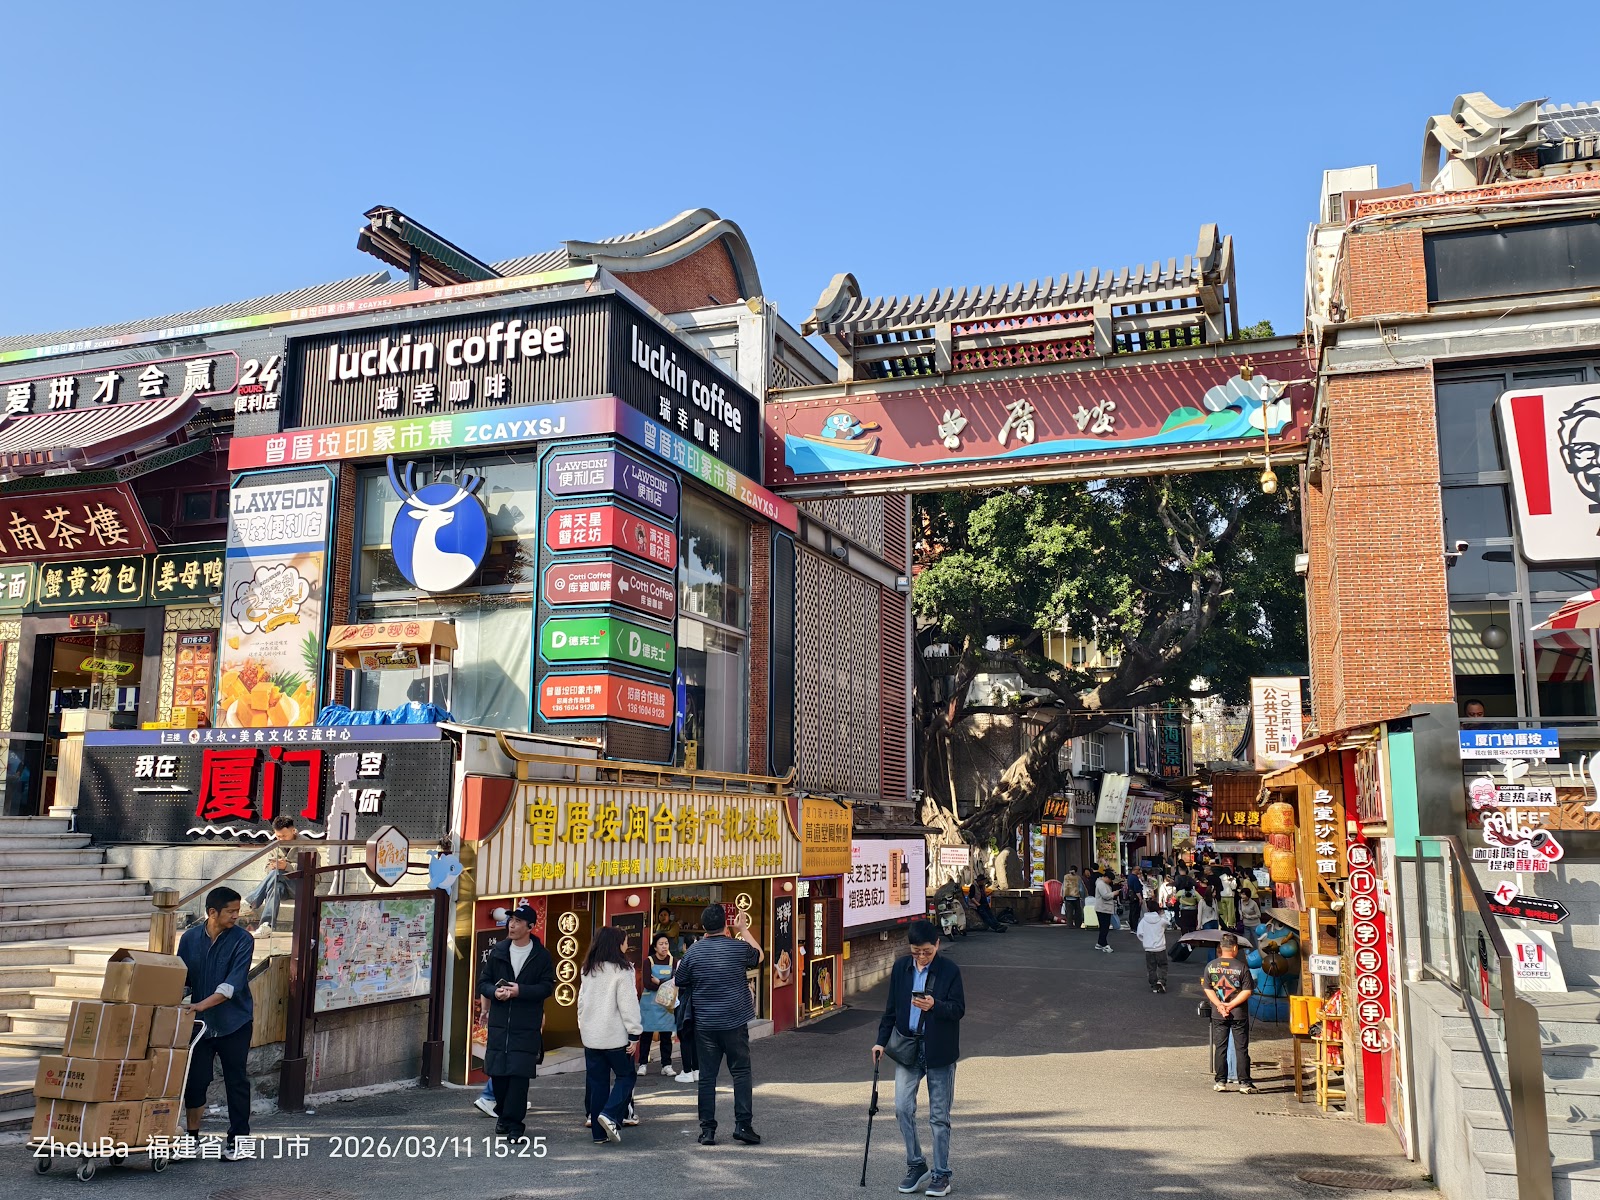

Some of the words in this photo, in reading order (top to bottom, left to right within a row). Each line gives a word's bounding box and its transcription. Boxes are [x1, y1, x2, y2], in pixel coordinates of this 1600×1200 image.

[328, 334, 435, 381] luckin
[445, 319, 565, 367] coffee
[239, 355, 281, 392] 24
[631, 324, 688, 398] luckin
[691, 377, 742, 434] coffee
[5, 358, 214, 414] 爱拼才会赢
[239, 384, 263, 394] HOURS
[376, 373, 507, 411] 瑞幸咖啡
[234, 392, 278, 413] 便利店
[658, 395, 720, 452] 瑞幸咖啡
[937, 398, 1117, 451] 曾厝垵
[265, 419, 453, 464] 曾厝垵印象市集
[464, 416, 567, 442] ZCAYXSJ
[556, 458, 605, 472] LAWSON
[644, 420, 737, 495] 曾厝垵印象市集
[740, 485, 779, 520] ZCAYXSJ
[558, 470, 605, 487] 便利店
[631, 465, 666, 493] LAWSON
[233, 486, 325, 514] LAWSON
[637, 482, 662, 508] 便利店
[0, 503, 130, 554] 南茶樓
[231, 511, 323, 544] 罗森便利店
[559, 512, 602, 529] 满天星
[558, 527, 602, 545] 簪花坊
[649, 527, 671, 549] 满天星
[44, 563, 139, 599] 蟹黄汤包
[156, 556, 224, 592] 姜母鸭
[568, 573, 587, 581] Cotti
[587, 572, 612, 580] Coffee
[568, 581, 612, 593] 库迪咖啡
[629, 575, 649, 594] Cotti
[649, 582, 674, 602] Coffee
[640, 594, 664, 611] 库迪咖啡
[568, 634, 601, 646] 德克士
[641, 643, 667, 663] 德克士
[627, 686, 666, 707] 招商合作热线
[1263, 687, 1280, 754] 公共卫生间
[1281, 692, 1292, 733] TOILET
[165, 732, 181, 743] 三楼
[1474, 732, 1542, 747] 厦门曾厝垵
[134, 754, 177, 778] 我在
[195, 746, 325, 821] 厦门
[349, 788, 384, 814] 你
[1498, 792, 1553, 803] 趁热拿铁
[1218, 811, 1260, 827] 八婆婆
[1312, 788, 1338, 874] 乌堂沙茶面
[1474, 847, 1529, 859] 咖啡喝饱
[1545, 845, 1554, 854] K
[519, 861, 566, 881] 全国包邮
[586, 857, 641, 879] 金门高粱酒
[1490, 859, 1549, 872] 提神醒脑
[848, 887, 885, 909] 增强免疫力
[1496, 884, 1513, 901] K
[1350, 844, 1385, 1050] 厦门老字号伴手礼
[1313, 958, 1337, 967] 打卡收藏
[1516, 970, 1549, 978] KCOFFEE
[1523, 961, 1541, 969] KFC
